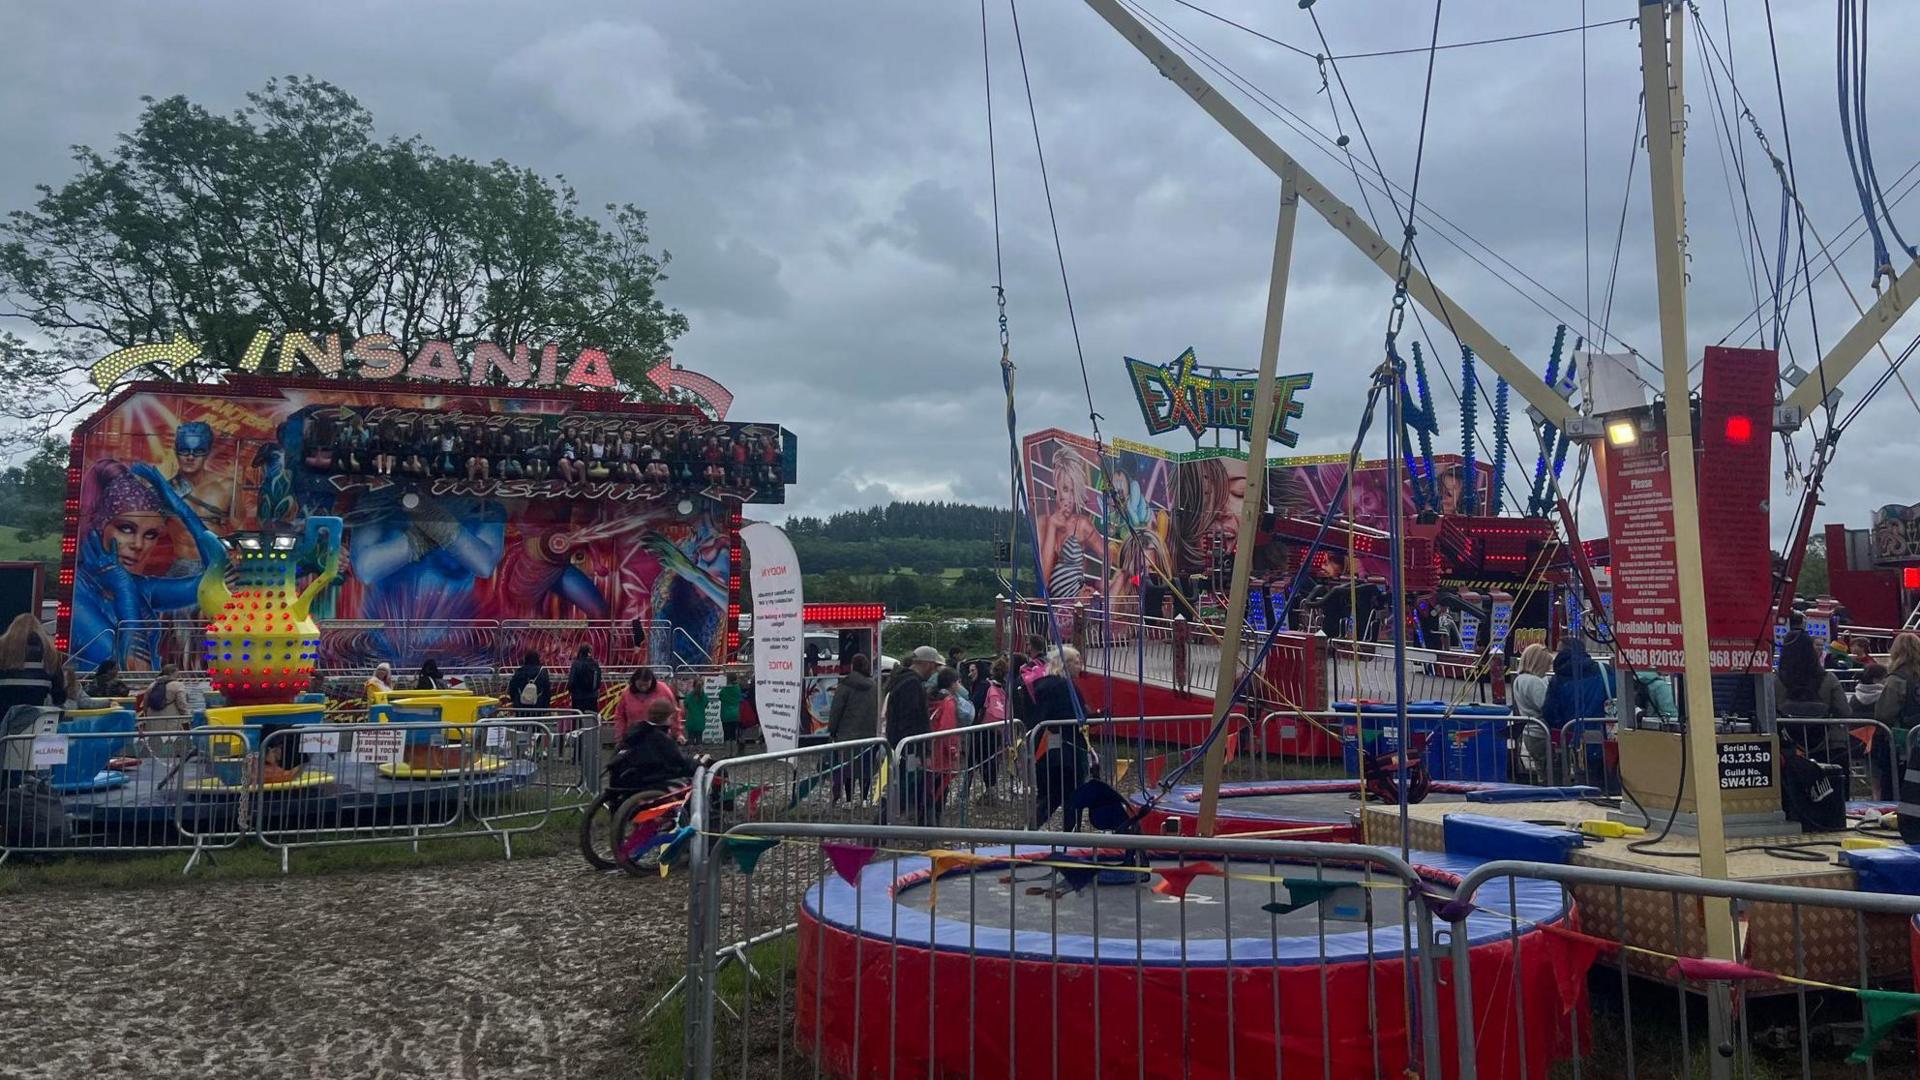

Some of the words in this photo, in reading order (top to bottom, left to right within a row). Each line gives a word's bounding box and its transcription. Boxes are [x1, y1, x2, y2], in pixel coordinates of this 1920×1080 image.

[238, 329, 617, 388] INSANIA
[1124, 347, 1313, 449] EXTREE
[1616, 621, 1653, 634] Available
[1654, 621, 1666, 634] for
[1650, 649, 1685, 667] 820132
[1723, 744, 1747, 752] Serial
[1717, 752, 1771, 764] 43.23.SD
[1724, 768, 1746, 777] Guild
[1720, 776, 1769, 788] SW41/23
